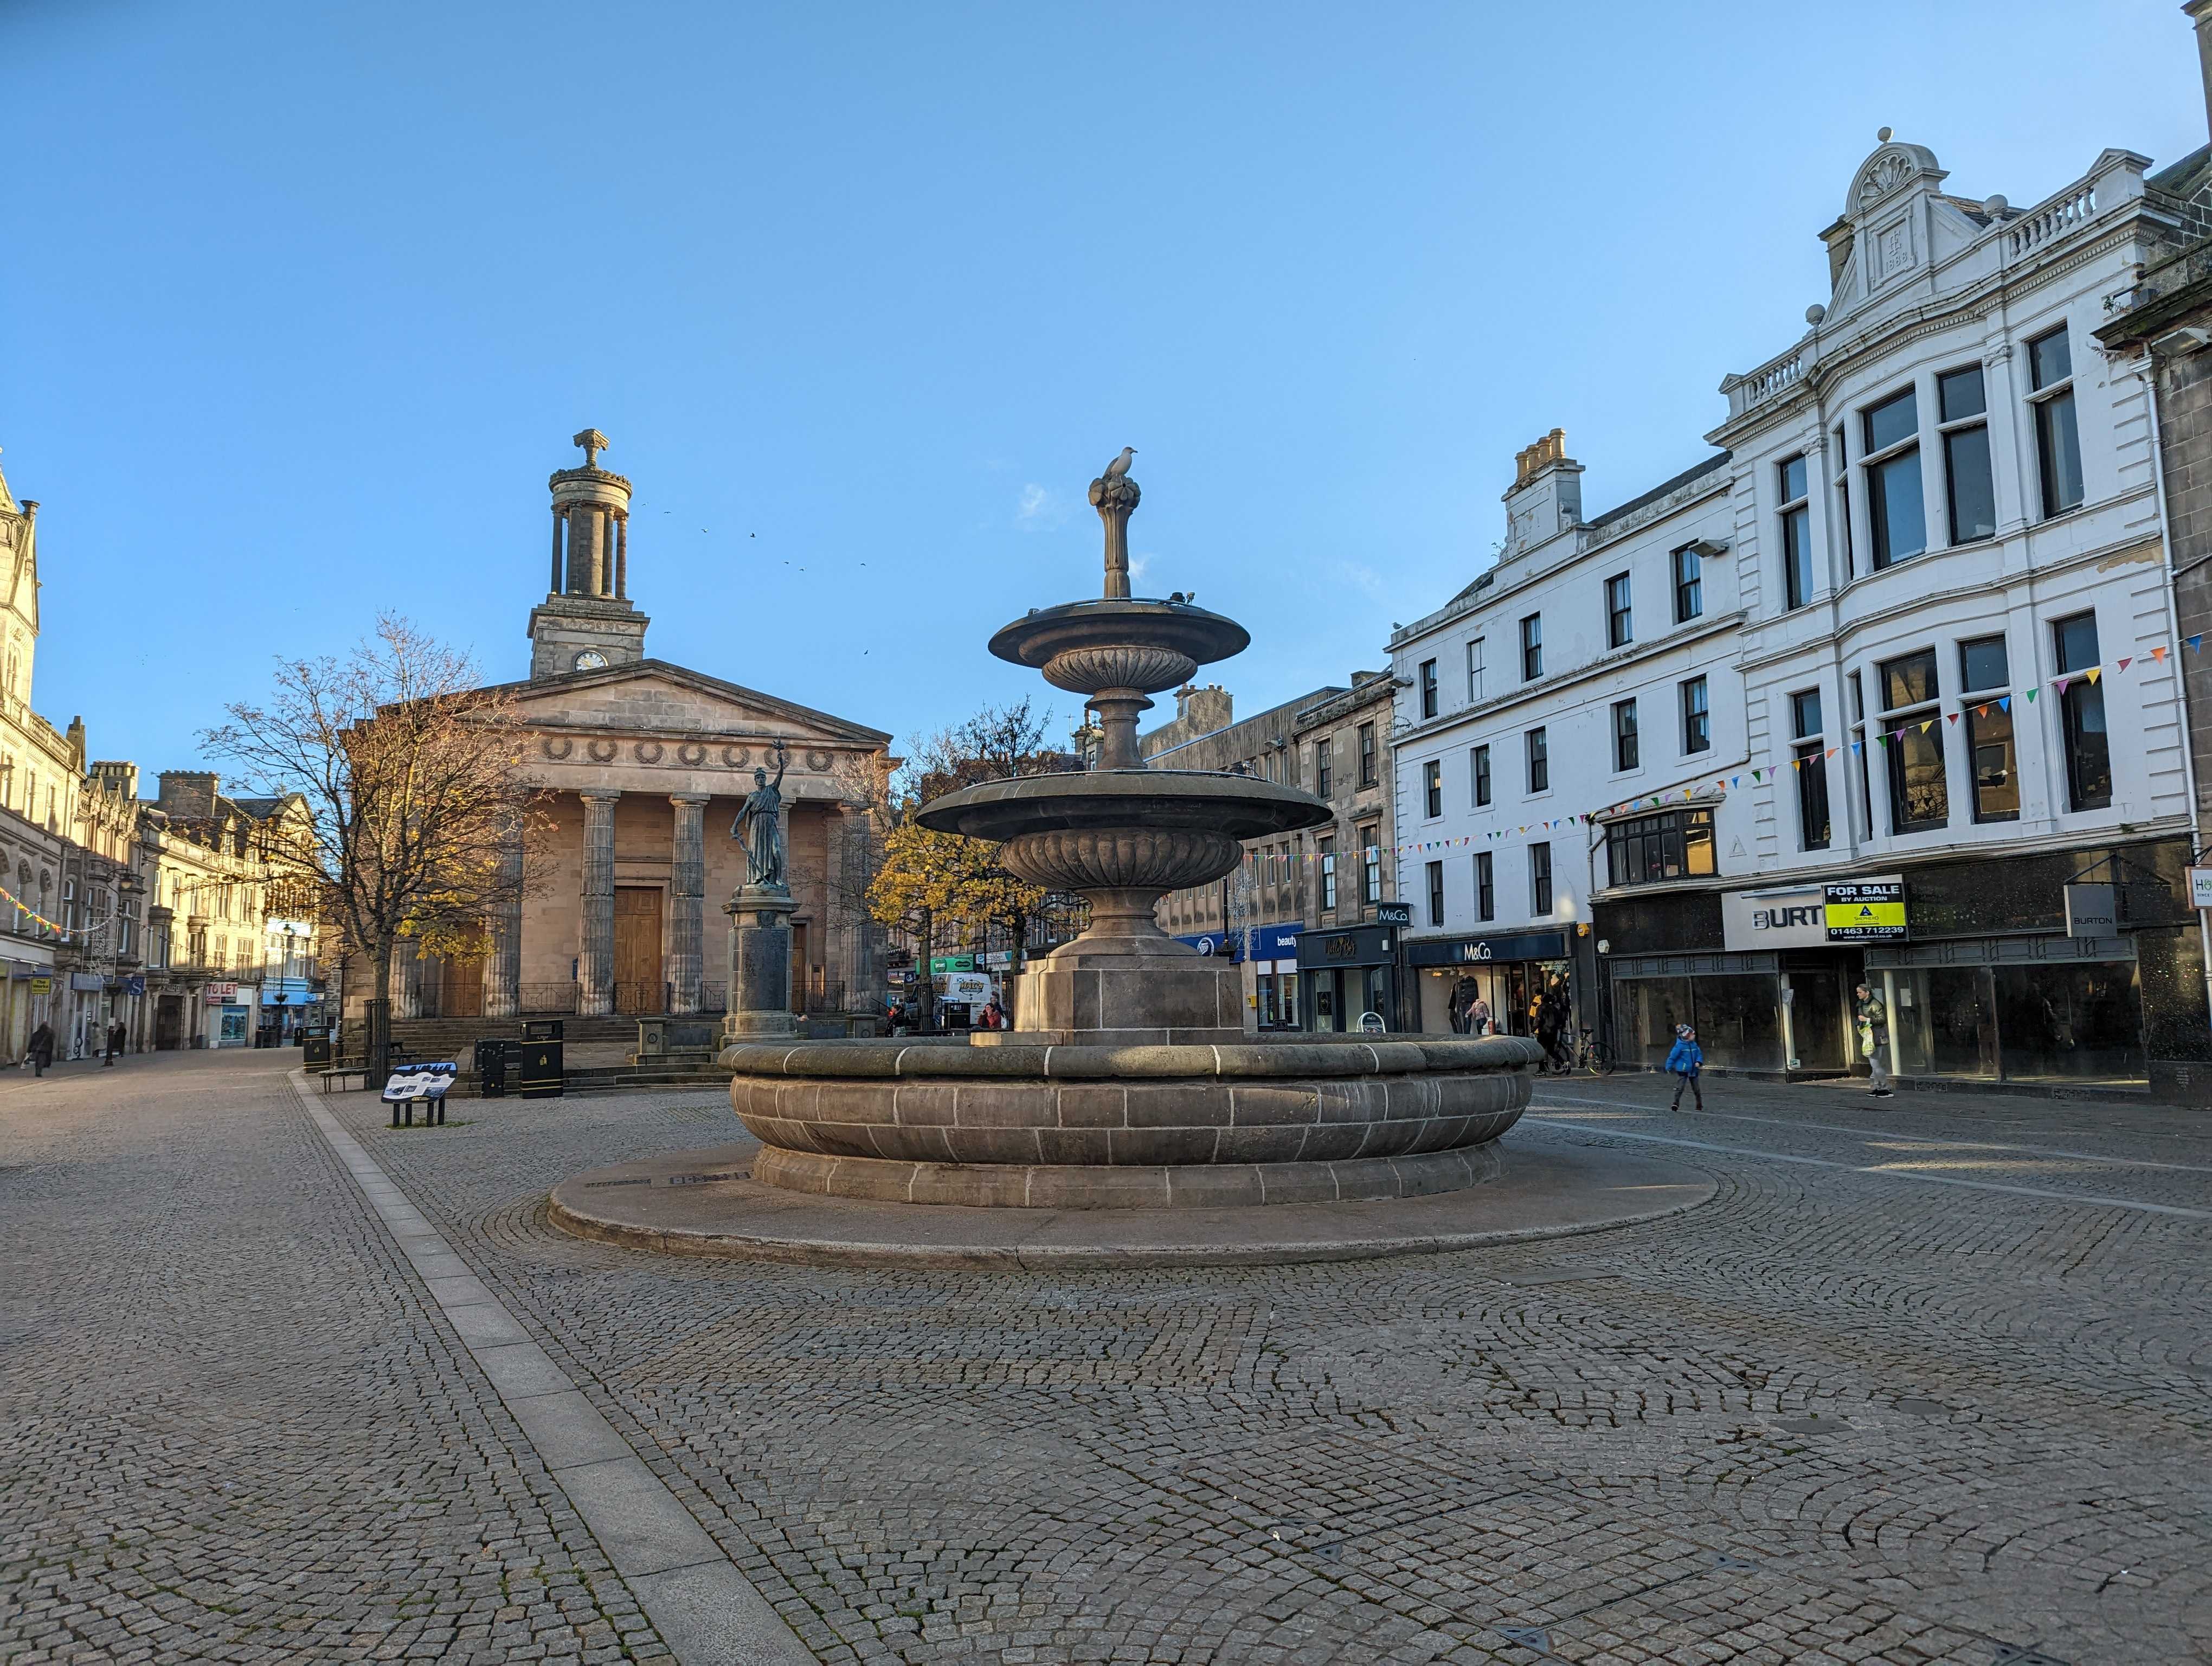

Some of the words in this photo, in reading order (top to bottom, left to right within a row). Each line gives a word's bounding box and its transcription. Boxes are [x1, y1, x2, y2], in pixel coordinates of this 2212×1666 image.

[1828, 887, 1856, 896] FOR
[1862, 885, 1900, 895] SALE
[1379, 909, 1409, 921] M&Co.
[1752, 905, 1822, 930] BURT
[1277, 935, 1296, 947] beauty
[1464, 942, 1492, 961] M&Co.
[208, 983, 218, 994] TO
[220, 983, 237, 995] LET
